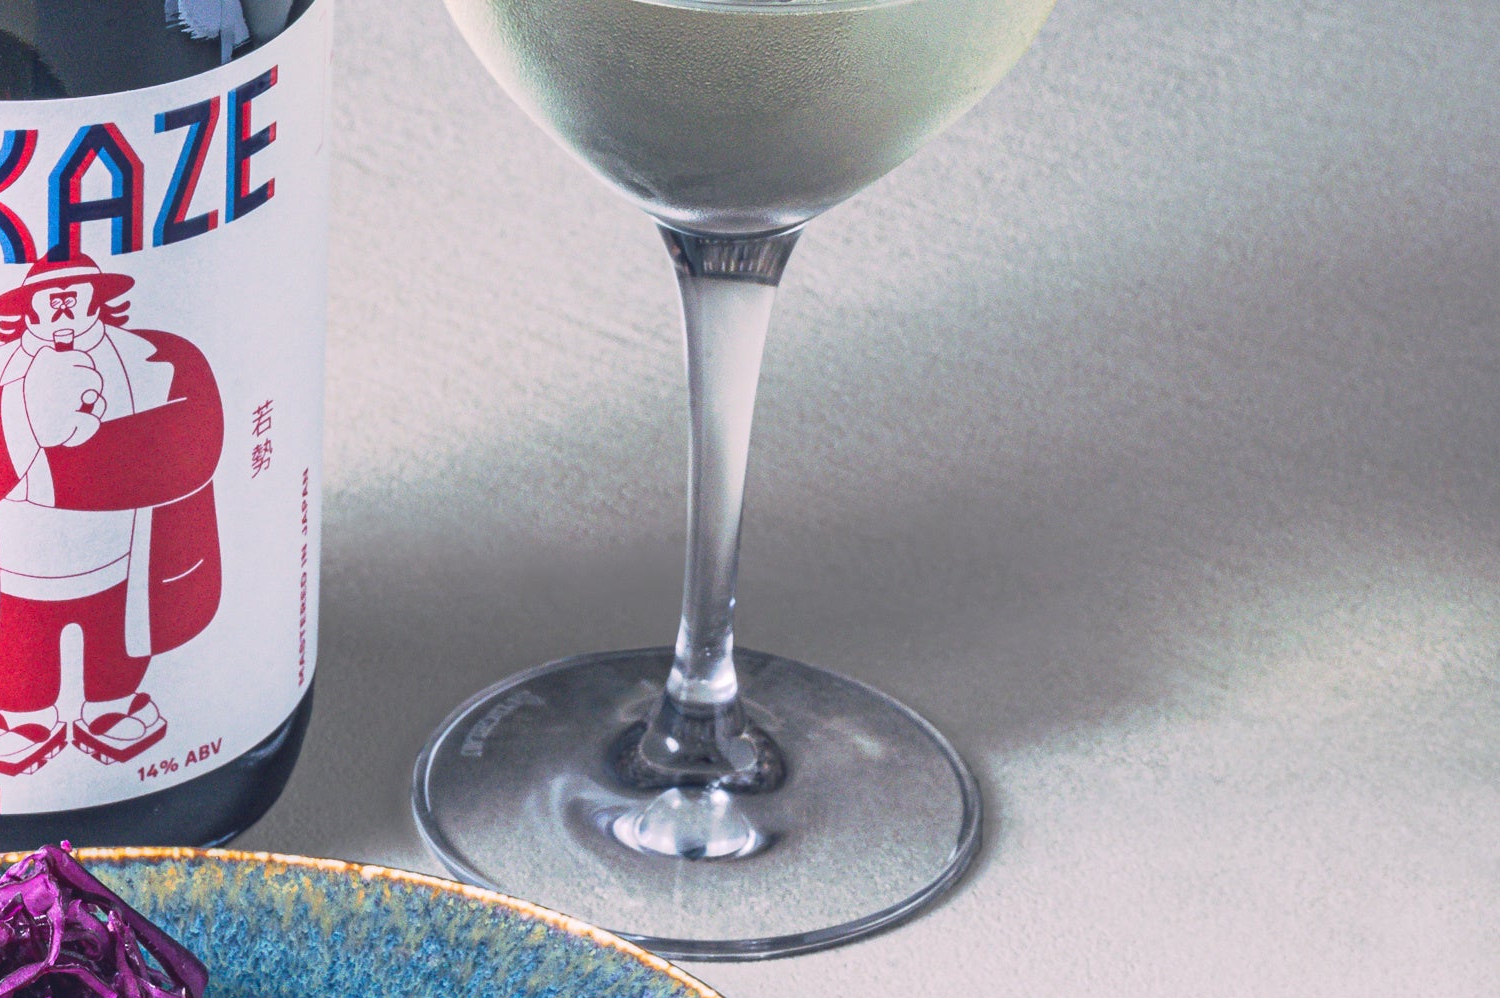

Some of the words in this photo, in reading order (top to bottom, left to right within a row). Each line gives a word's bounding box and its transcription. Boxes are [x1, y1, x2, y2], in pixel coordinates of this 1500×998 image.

[251, 399, 273, 478] 若勢
[300, 543, 307, 568] IN
[138, 758, 179, 781] 14%
[185, 737, 222, 767] ABV
